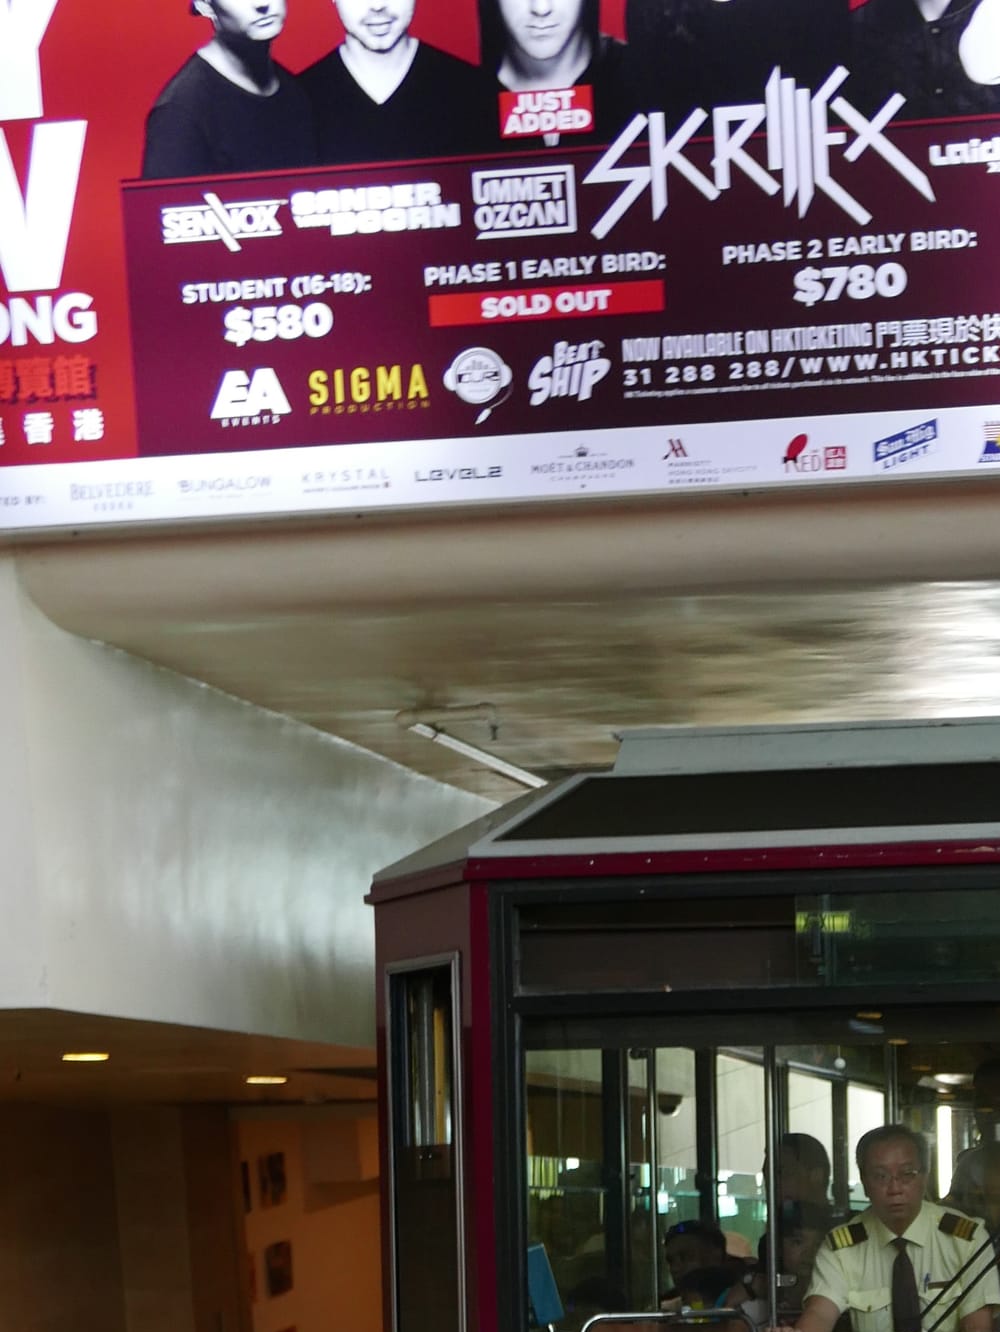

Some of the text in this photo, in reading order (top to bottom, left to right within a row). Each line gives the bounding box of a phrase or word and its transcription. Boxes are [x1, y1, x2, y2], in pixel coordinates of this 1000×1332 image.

[511, 89, 576, 114] JUST
[504, 109, 591, 134] ADDED
[473, 202, 568, 233] OZCAN
[722, 229, 977, 265] PHASE 2 EARLY BIRD:
[424, 252, 666, 286] PHASE 1 EARLY BIRD:
[793, 261, 908, 307] $780
[182, 271, 372, 304] STUDENT (16-18):
[481, 289, 611, 319] SOLD OUT
[223, 302, 334, 347] $580
[622, 336, 661, 363] NOW
[662, 331, 745, 360] AVAILABLE
[745, 329, 769, 355] ON
[770, 322, 873, 353] HKTICKETING
[308, 364, 430, 407] SIGMA
[527, 358, 612, 406] SHIP
[623, 368, 652, 386] 31
[665, 364, 717, 384] 288
